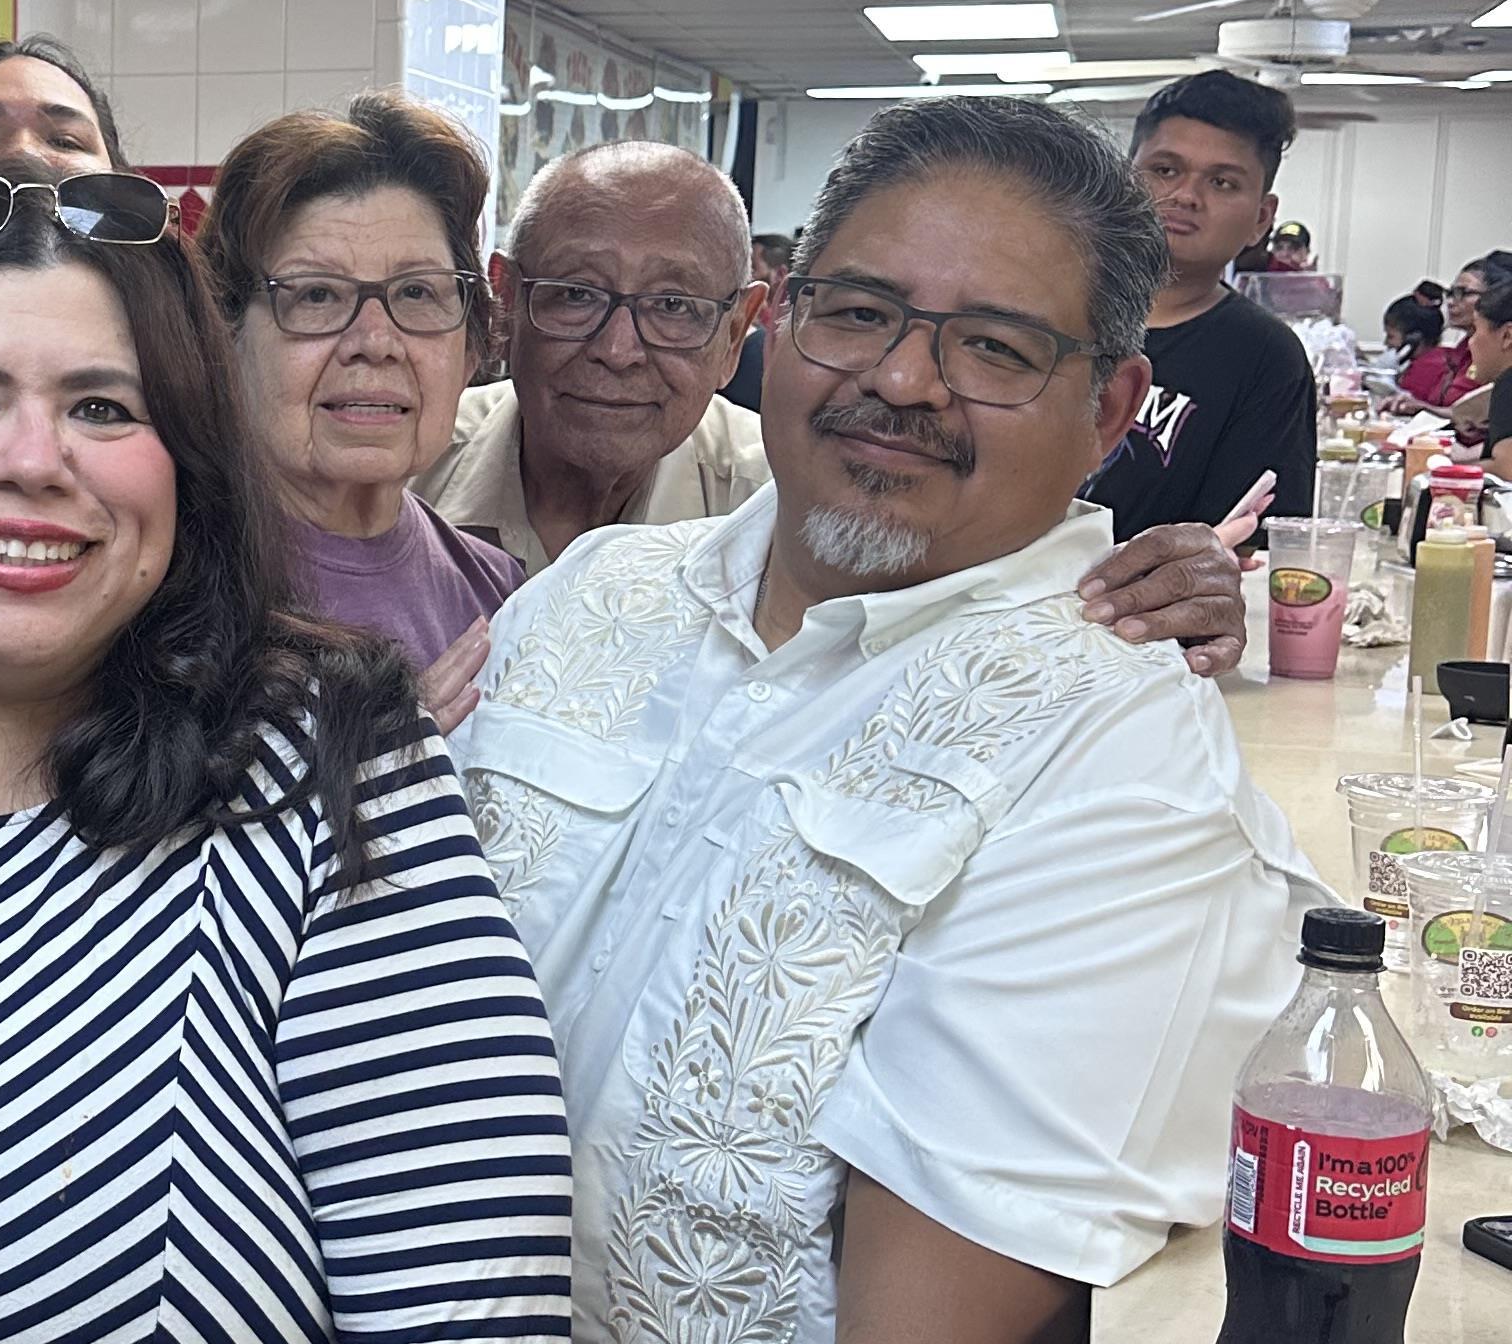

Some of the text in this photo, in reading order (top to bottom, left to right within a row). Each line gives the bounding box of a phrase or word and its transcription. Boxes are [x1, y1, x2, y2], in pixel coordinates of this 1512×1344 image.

[1319, 1152, 1355, 1174] I'm
[1357, 1161, 1373, 1175] a
[1292, 1145, 1306, 1234] RECYCLE ME AGAIN
[1315, 1174, 1412, 1202] Recycled
